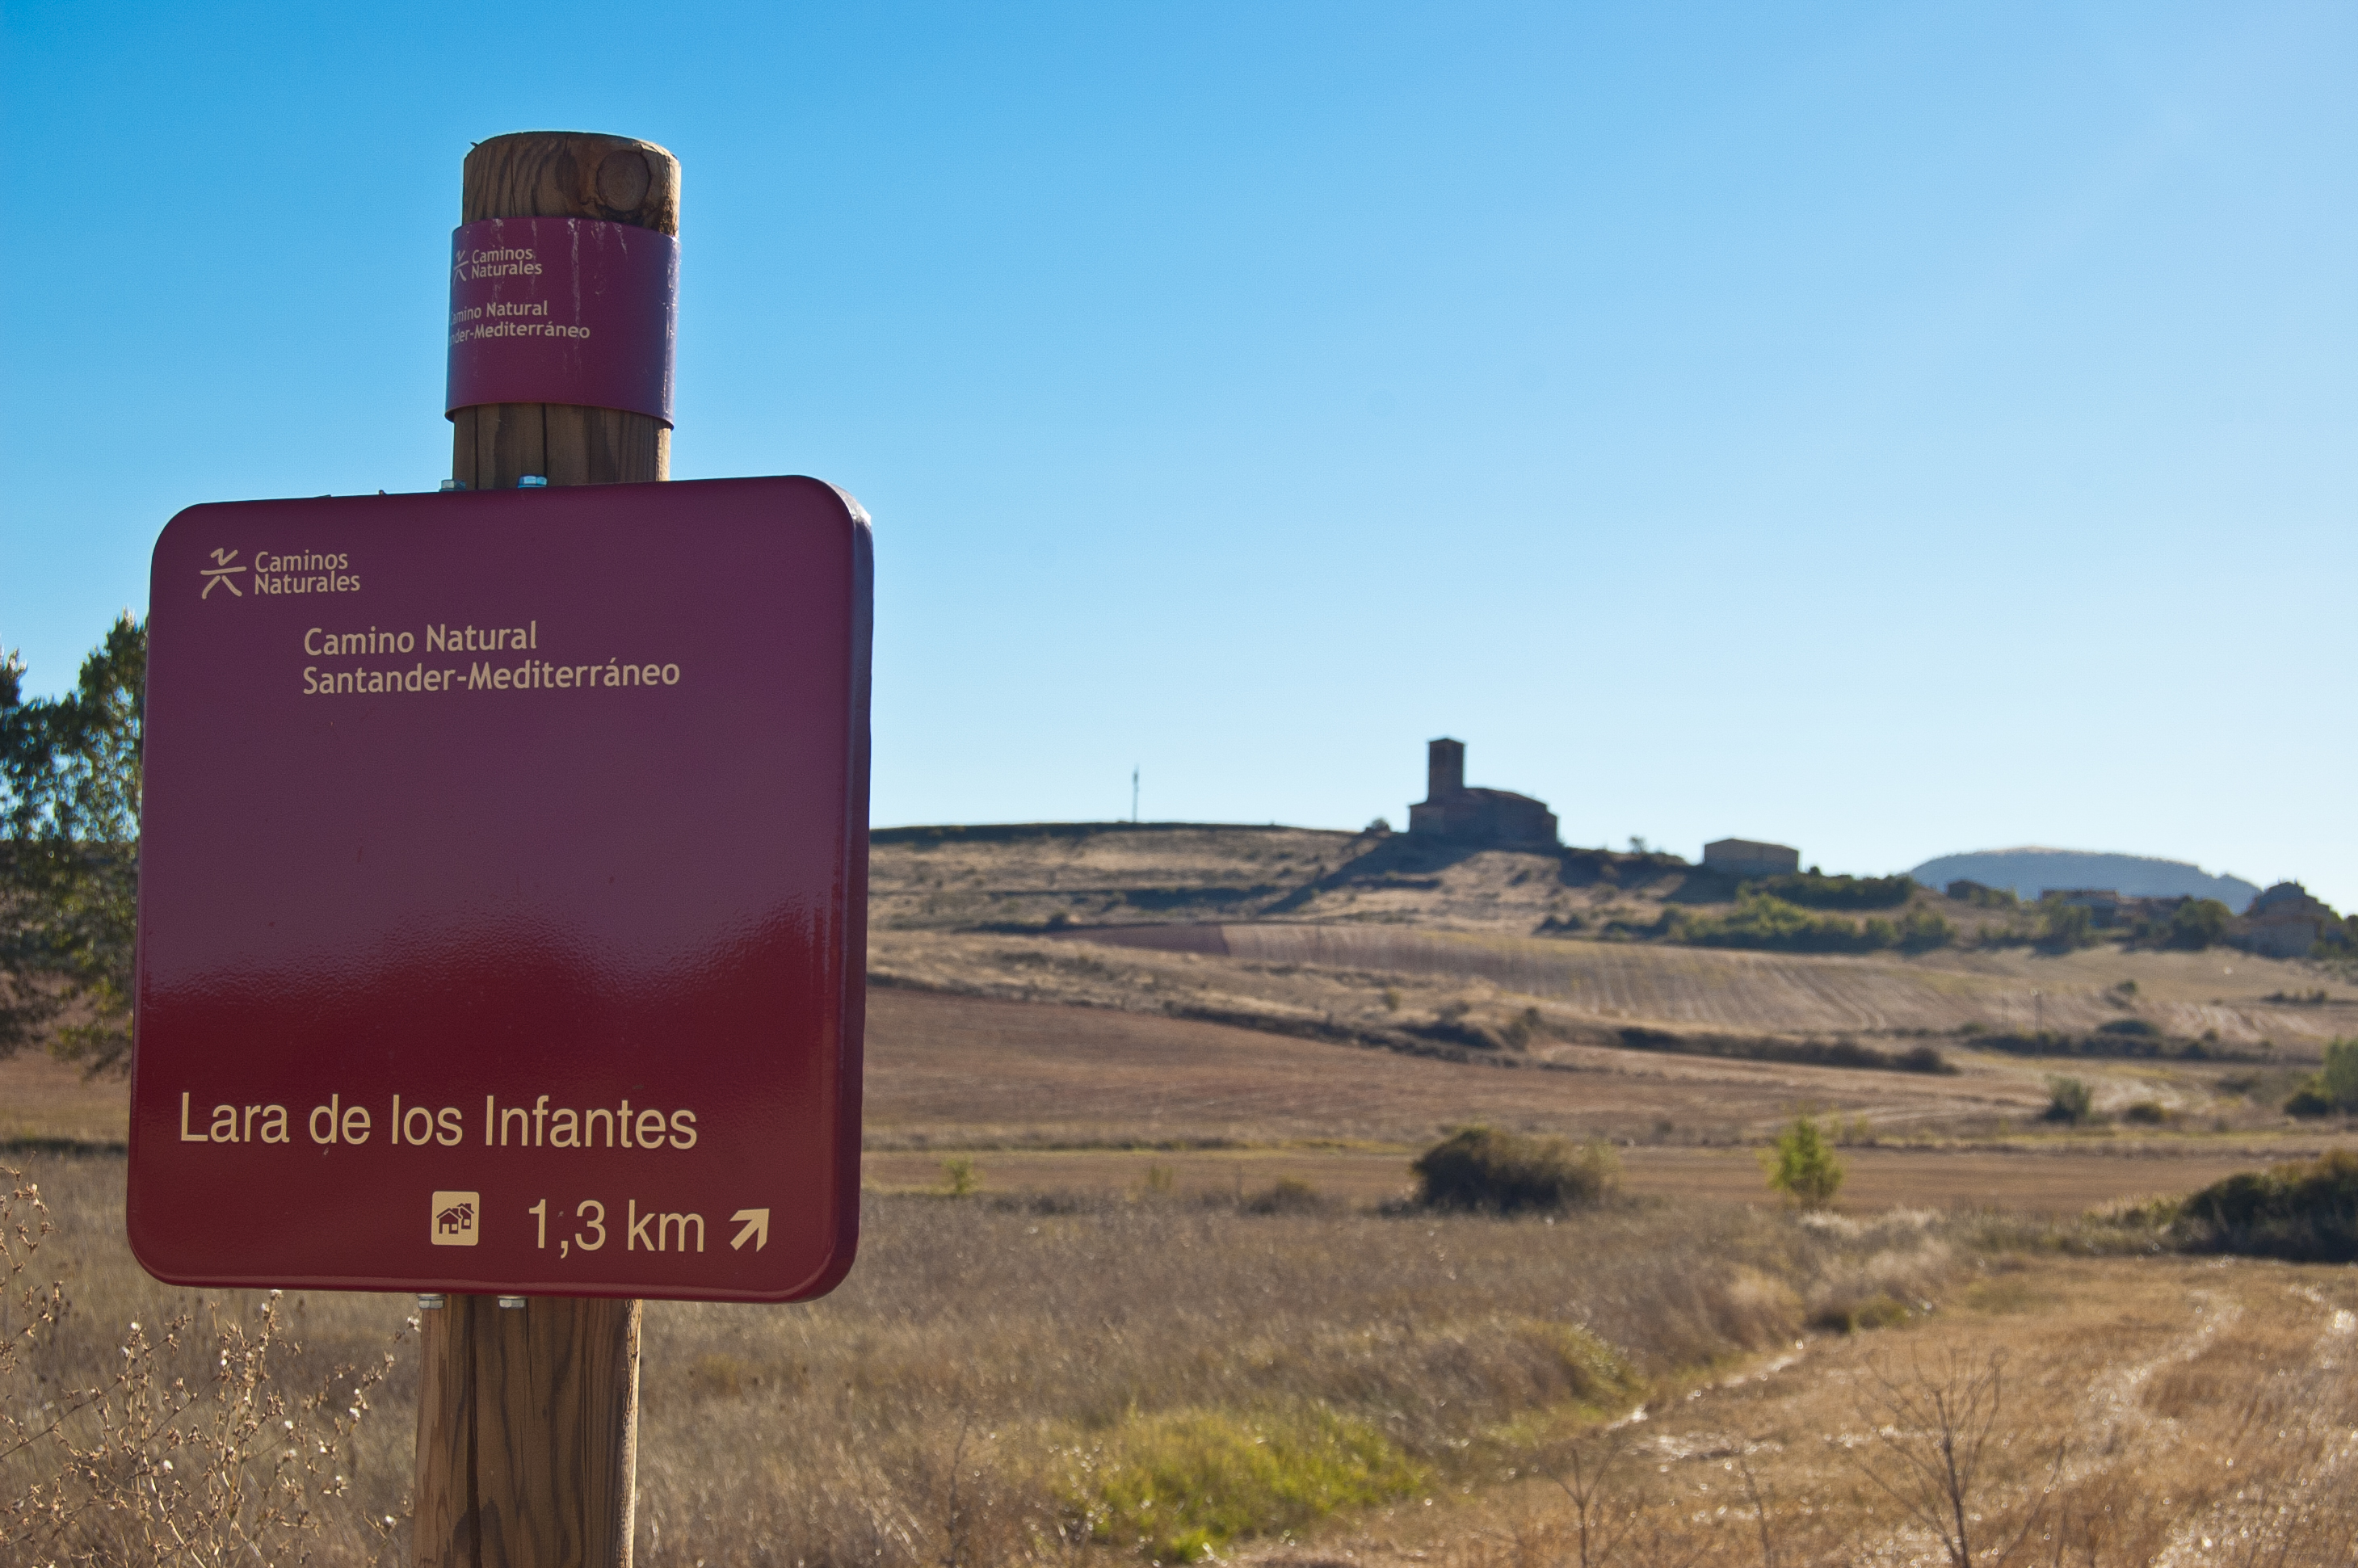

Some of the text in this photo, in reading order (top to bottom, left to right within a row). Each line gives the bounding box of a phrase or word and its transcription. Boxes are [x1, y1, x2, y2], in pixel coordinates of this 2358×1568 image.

[472, 246, 533, 264] Caminos
[471, 260, 543, 280] Naturales
[486, 301, 549, 318] Natural
[254, 549, 348, 573] Caminos
[254, 571, 361, 595] Naturales
[304, 620, 538, 656] Camino Natural
[302, 658, 681, 695] Santander-Mediterráneo
[179, 1091, 698, 1150] Lara de los Infantes
[528, 1199, 705, 1259] 1,3 km
